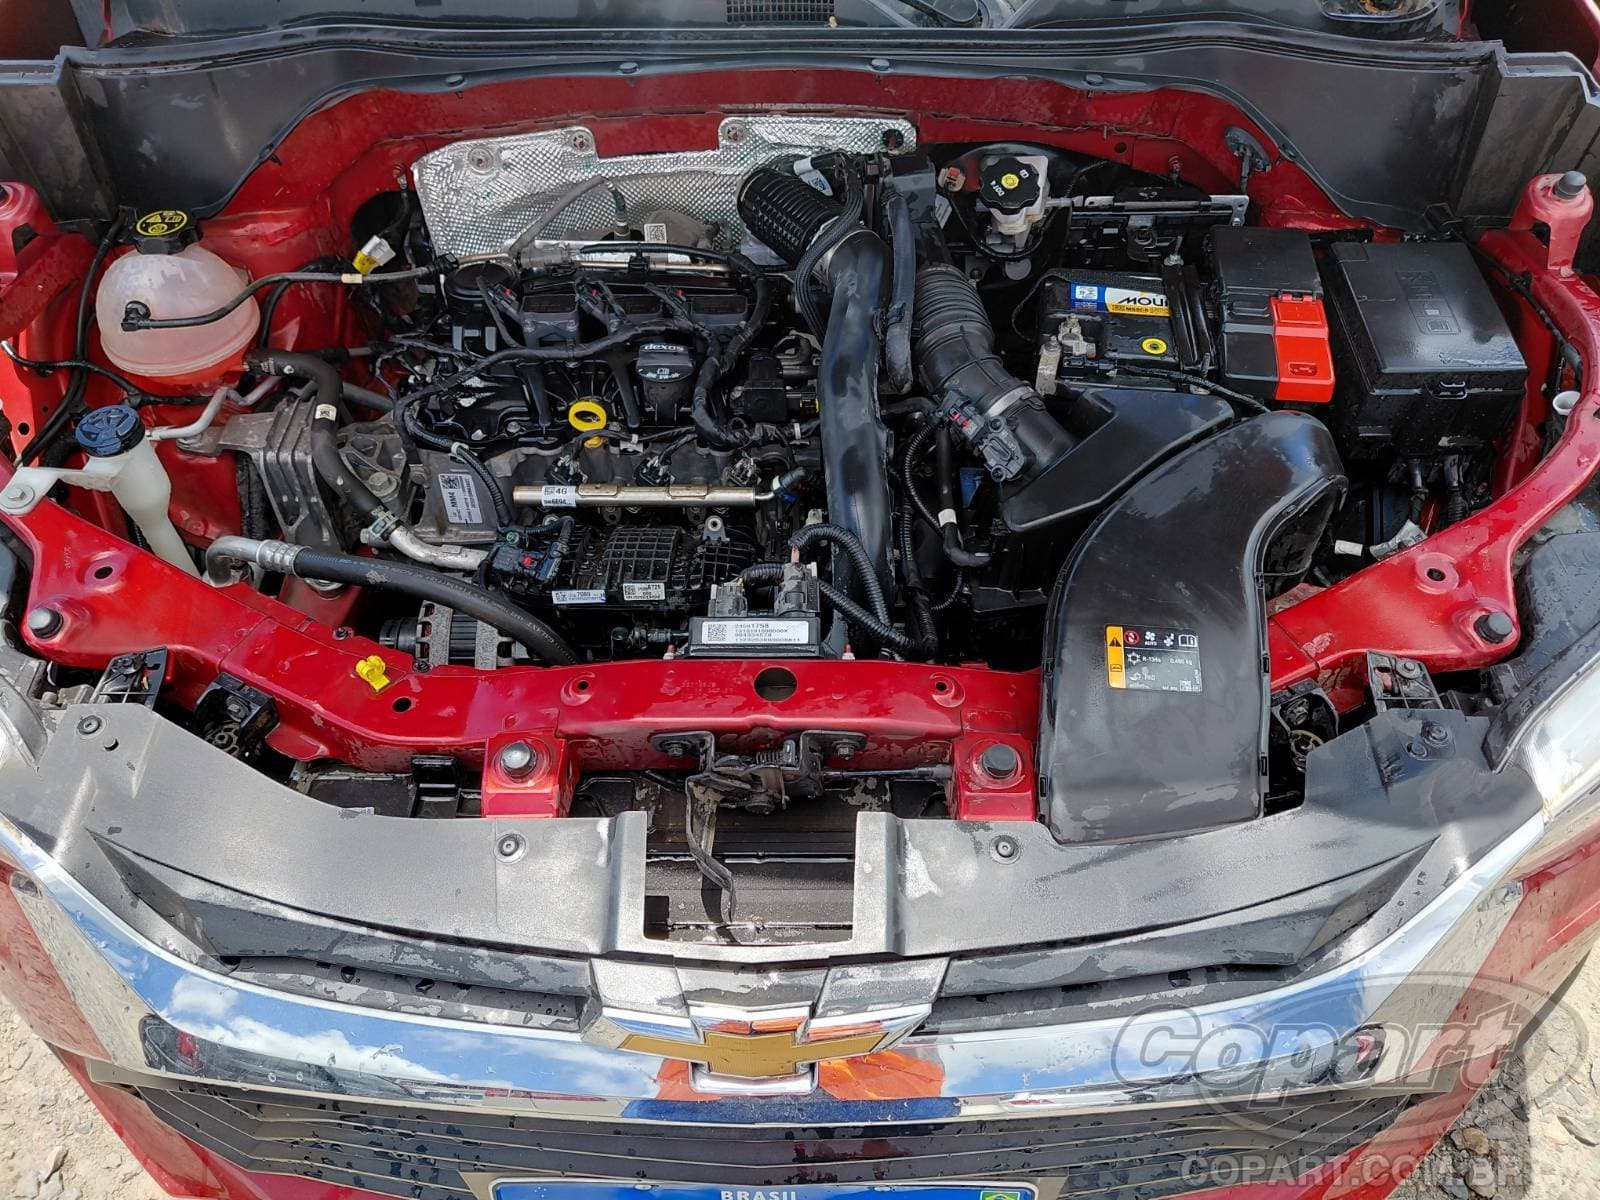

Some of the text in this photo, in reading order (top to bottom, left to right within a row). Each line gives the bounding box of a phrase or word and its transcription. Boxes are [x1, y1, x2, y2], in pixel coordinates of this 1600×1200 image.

[992, 185, 1005, 197] DOT
[644, 343, 684, 351] dexos
[720, 1190, 796, 1200] BRASIL
